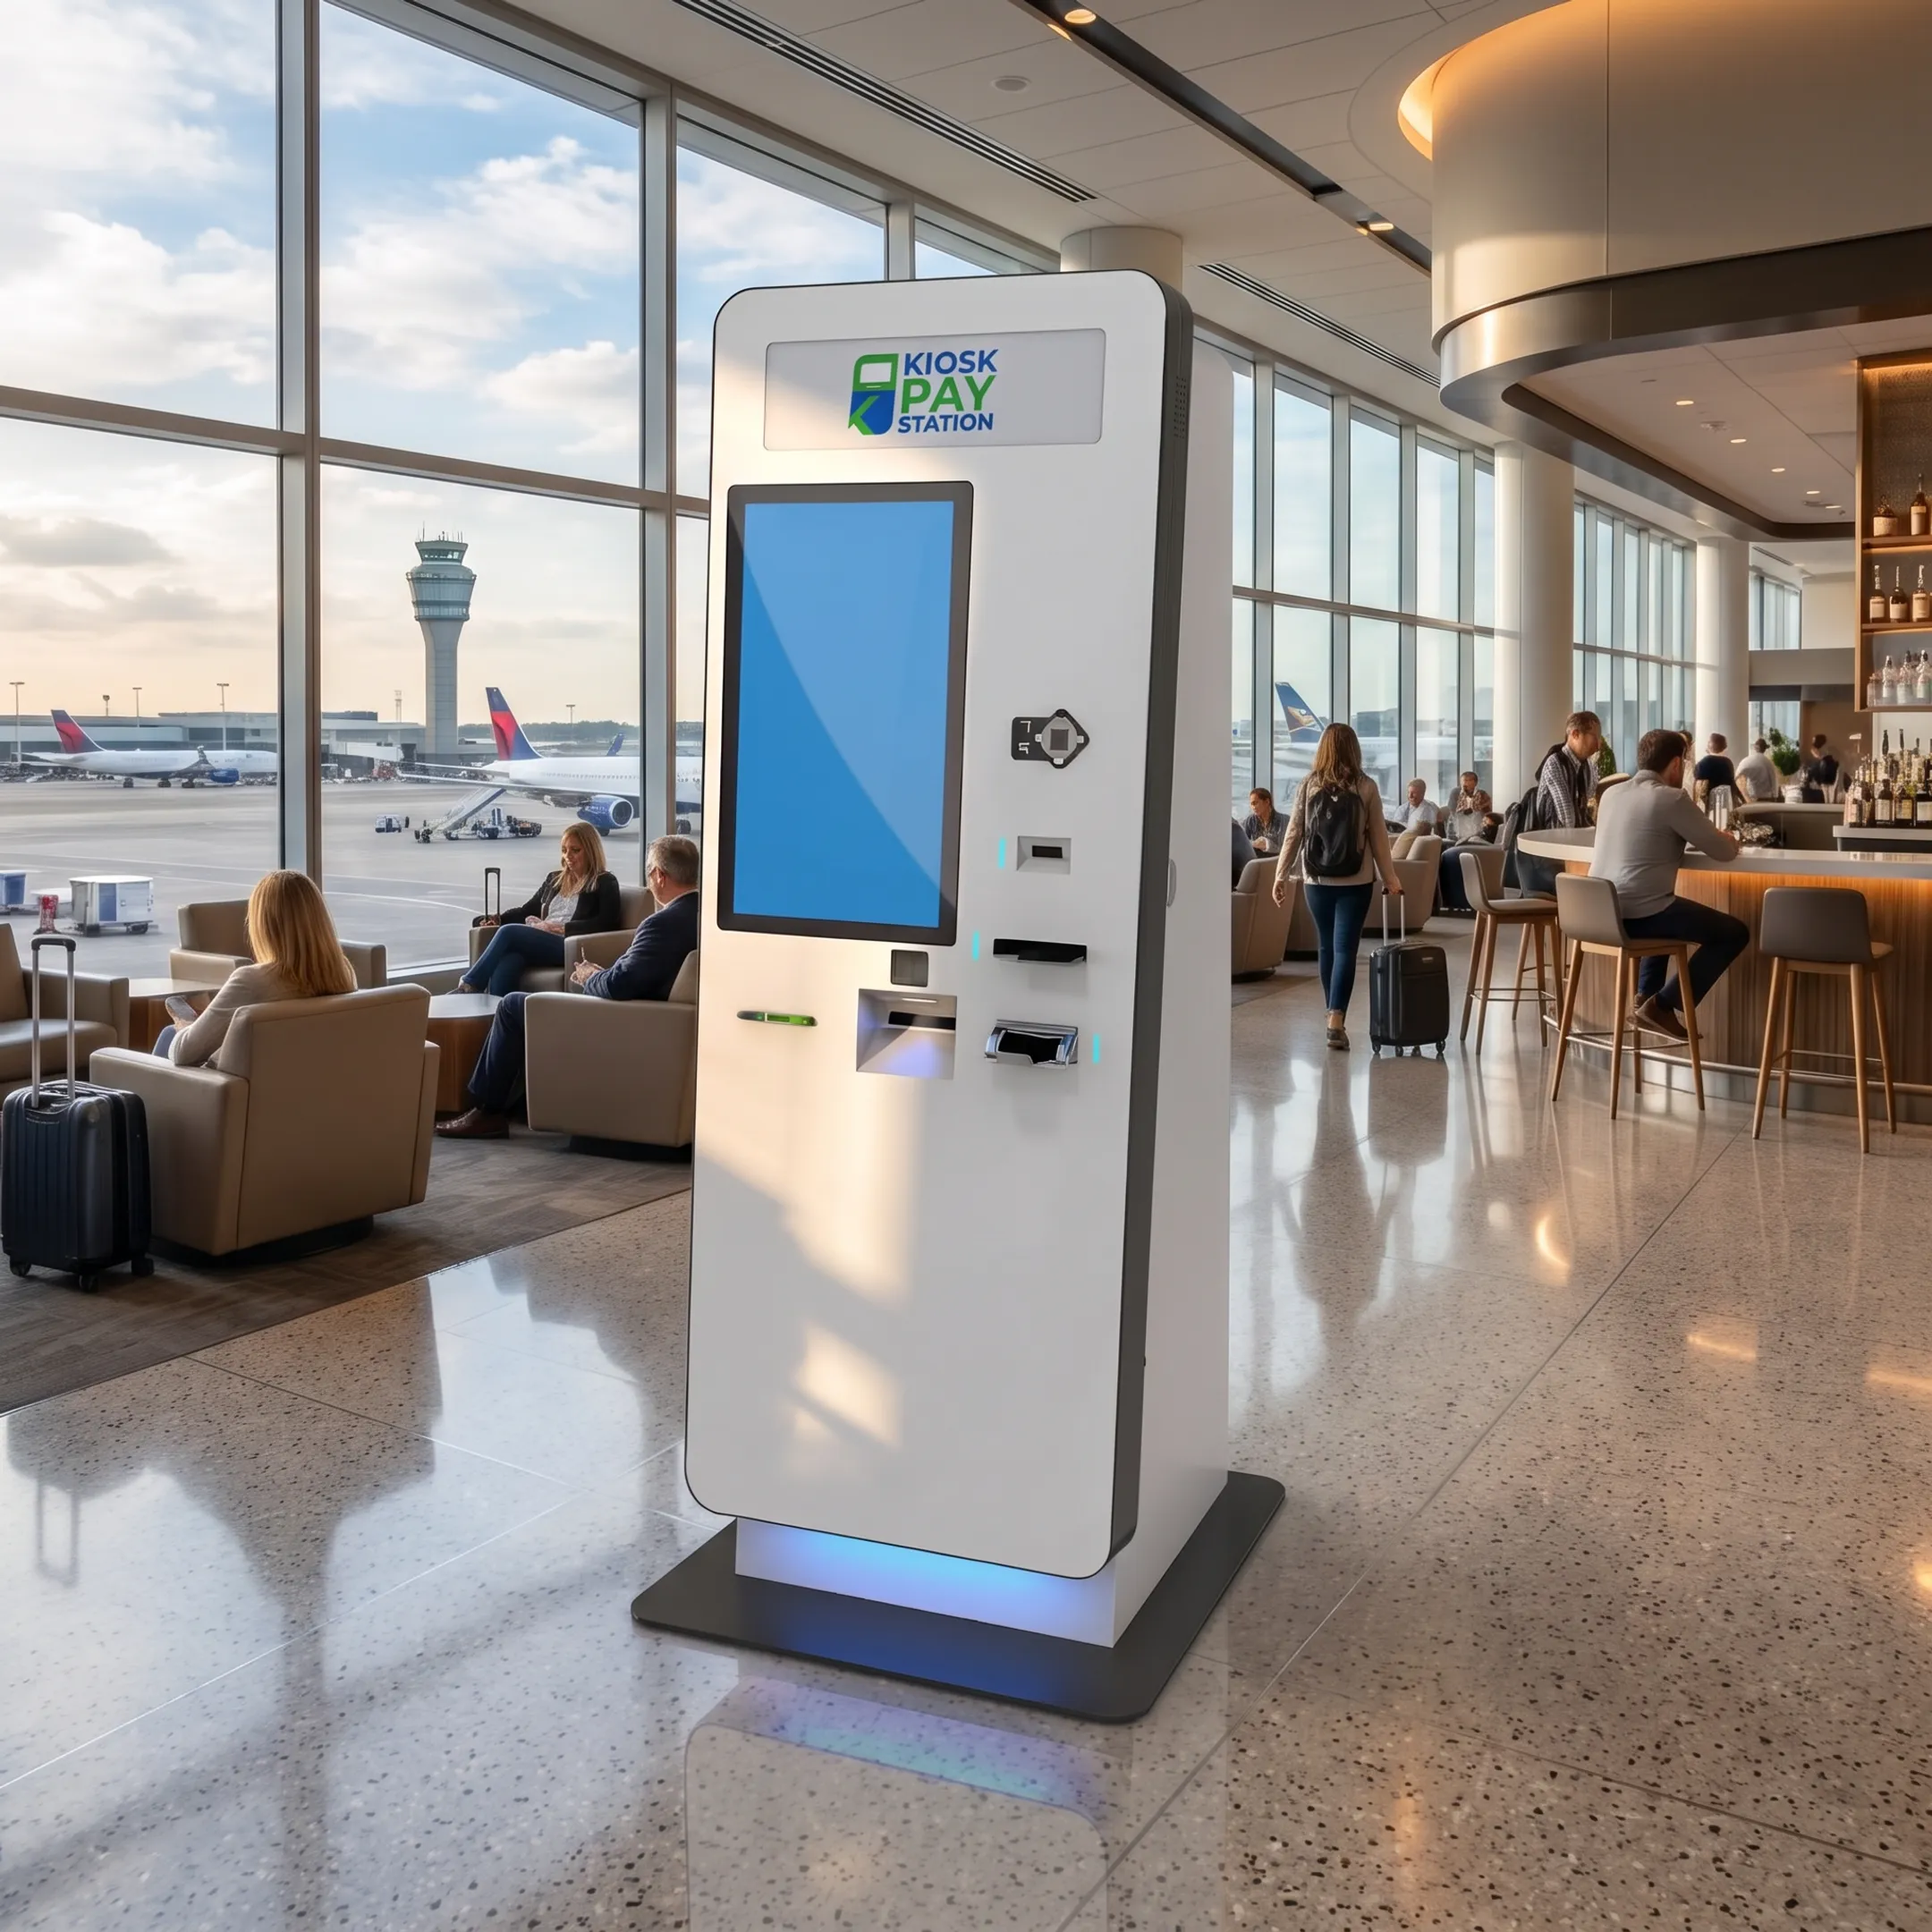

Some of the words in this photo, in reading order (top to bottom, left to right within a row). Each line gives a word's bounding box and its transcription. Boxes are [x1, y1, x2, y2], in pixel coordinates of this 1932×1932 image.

[903, 349, 999, 376] KIOSK
[901, 375, 996, 413] PAY
[897, 413, 994, 434] STATION
